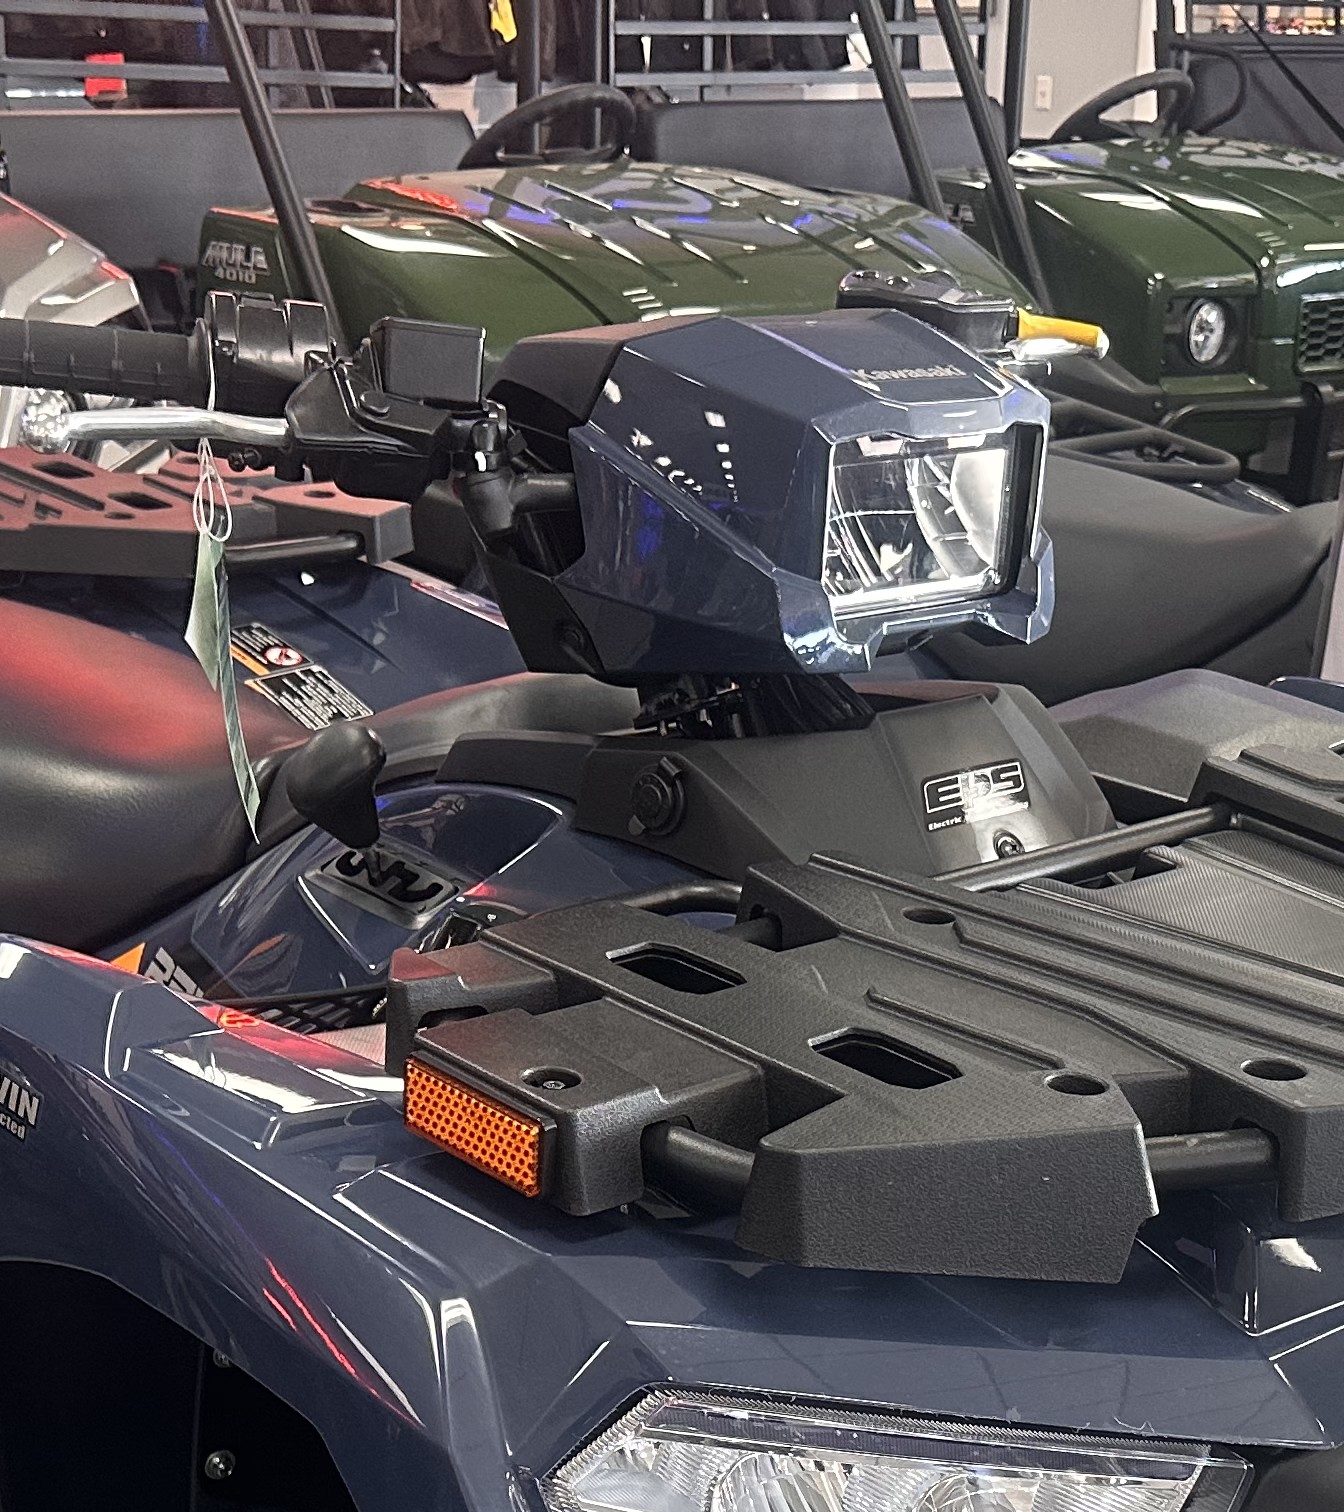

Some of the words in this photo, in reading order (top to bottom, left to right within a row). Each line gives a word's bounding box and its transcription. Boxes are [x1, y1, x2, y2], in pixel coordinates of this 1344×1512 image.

[202, 240, 269, 271] MULE
[851, 363, 967, 381] Kawasaki
[923, 761, 1025, 813] EPS
